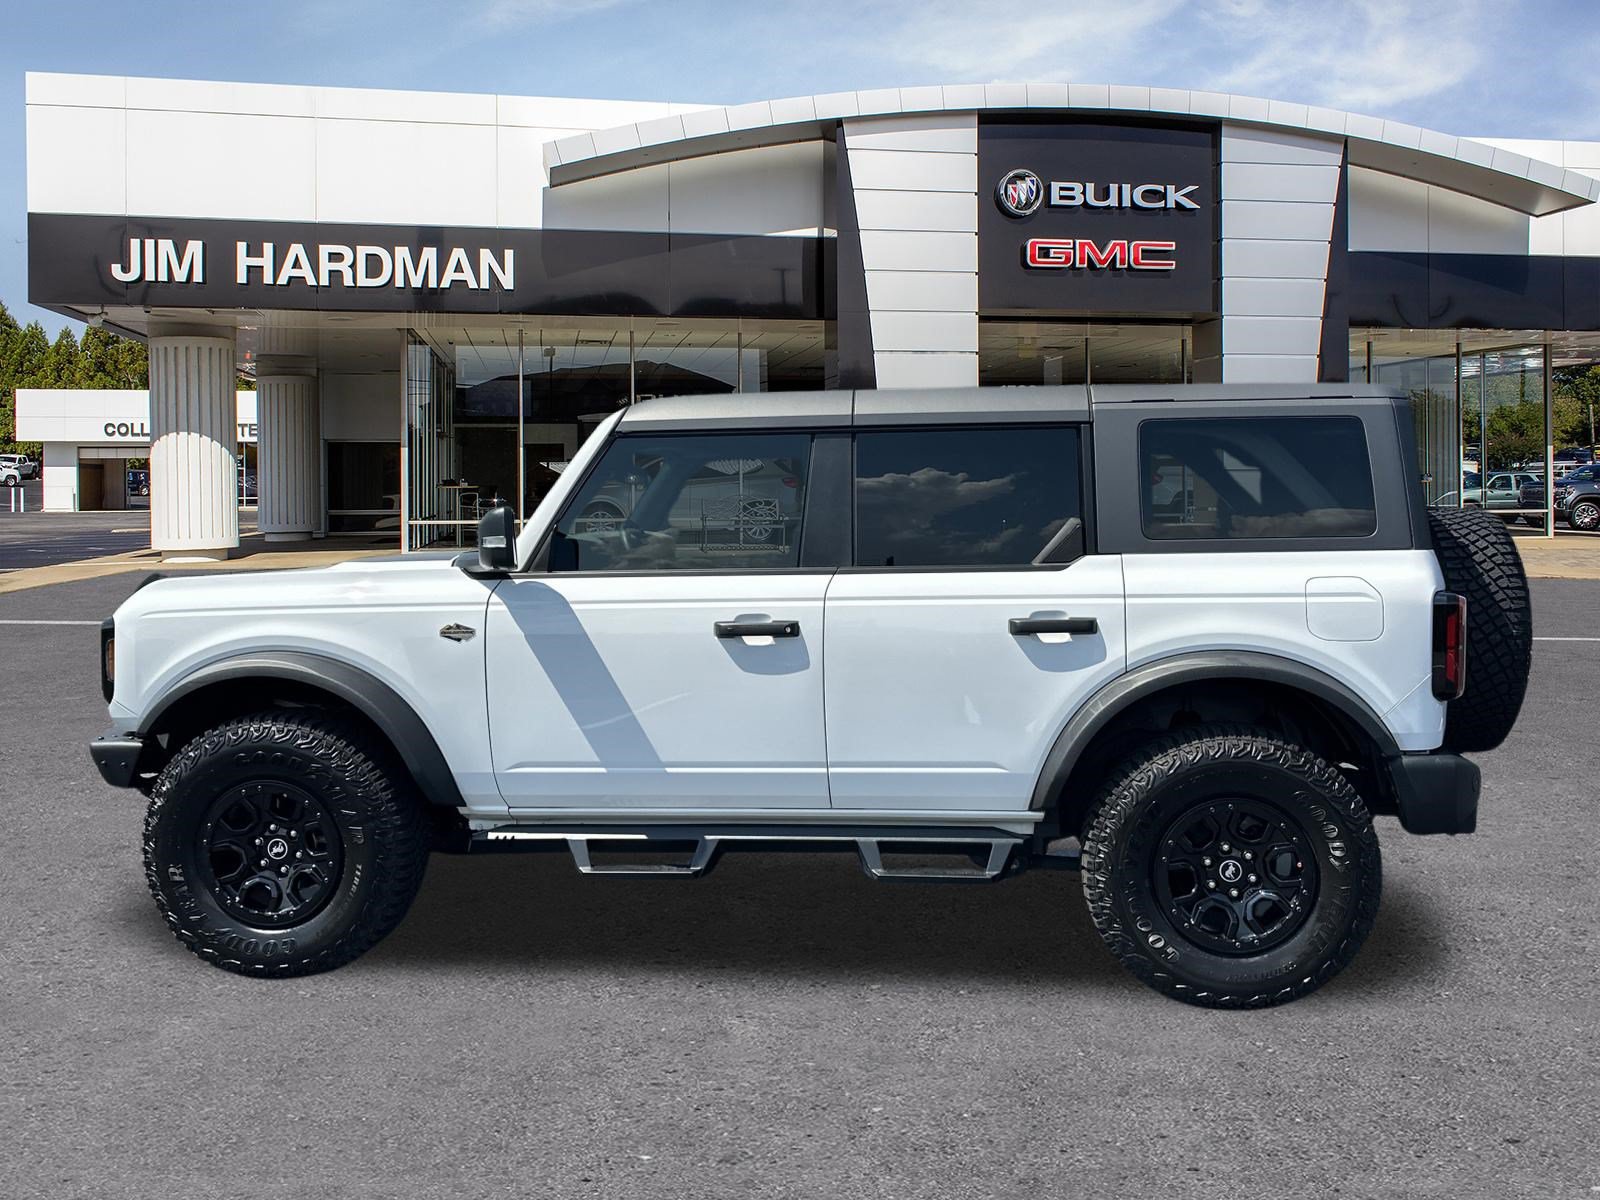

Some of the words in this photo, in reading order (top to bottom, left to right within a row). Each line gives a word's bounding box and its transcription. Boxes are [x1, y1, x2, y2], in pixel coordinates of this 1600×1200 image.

[1050, 181, 1201, 209] BUICK
[111, 237, 205, 284] JIM
[236, 241, 515, 291] HARDMAN
[1026, 238, 1176, 271] GMC
